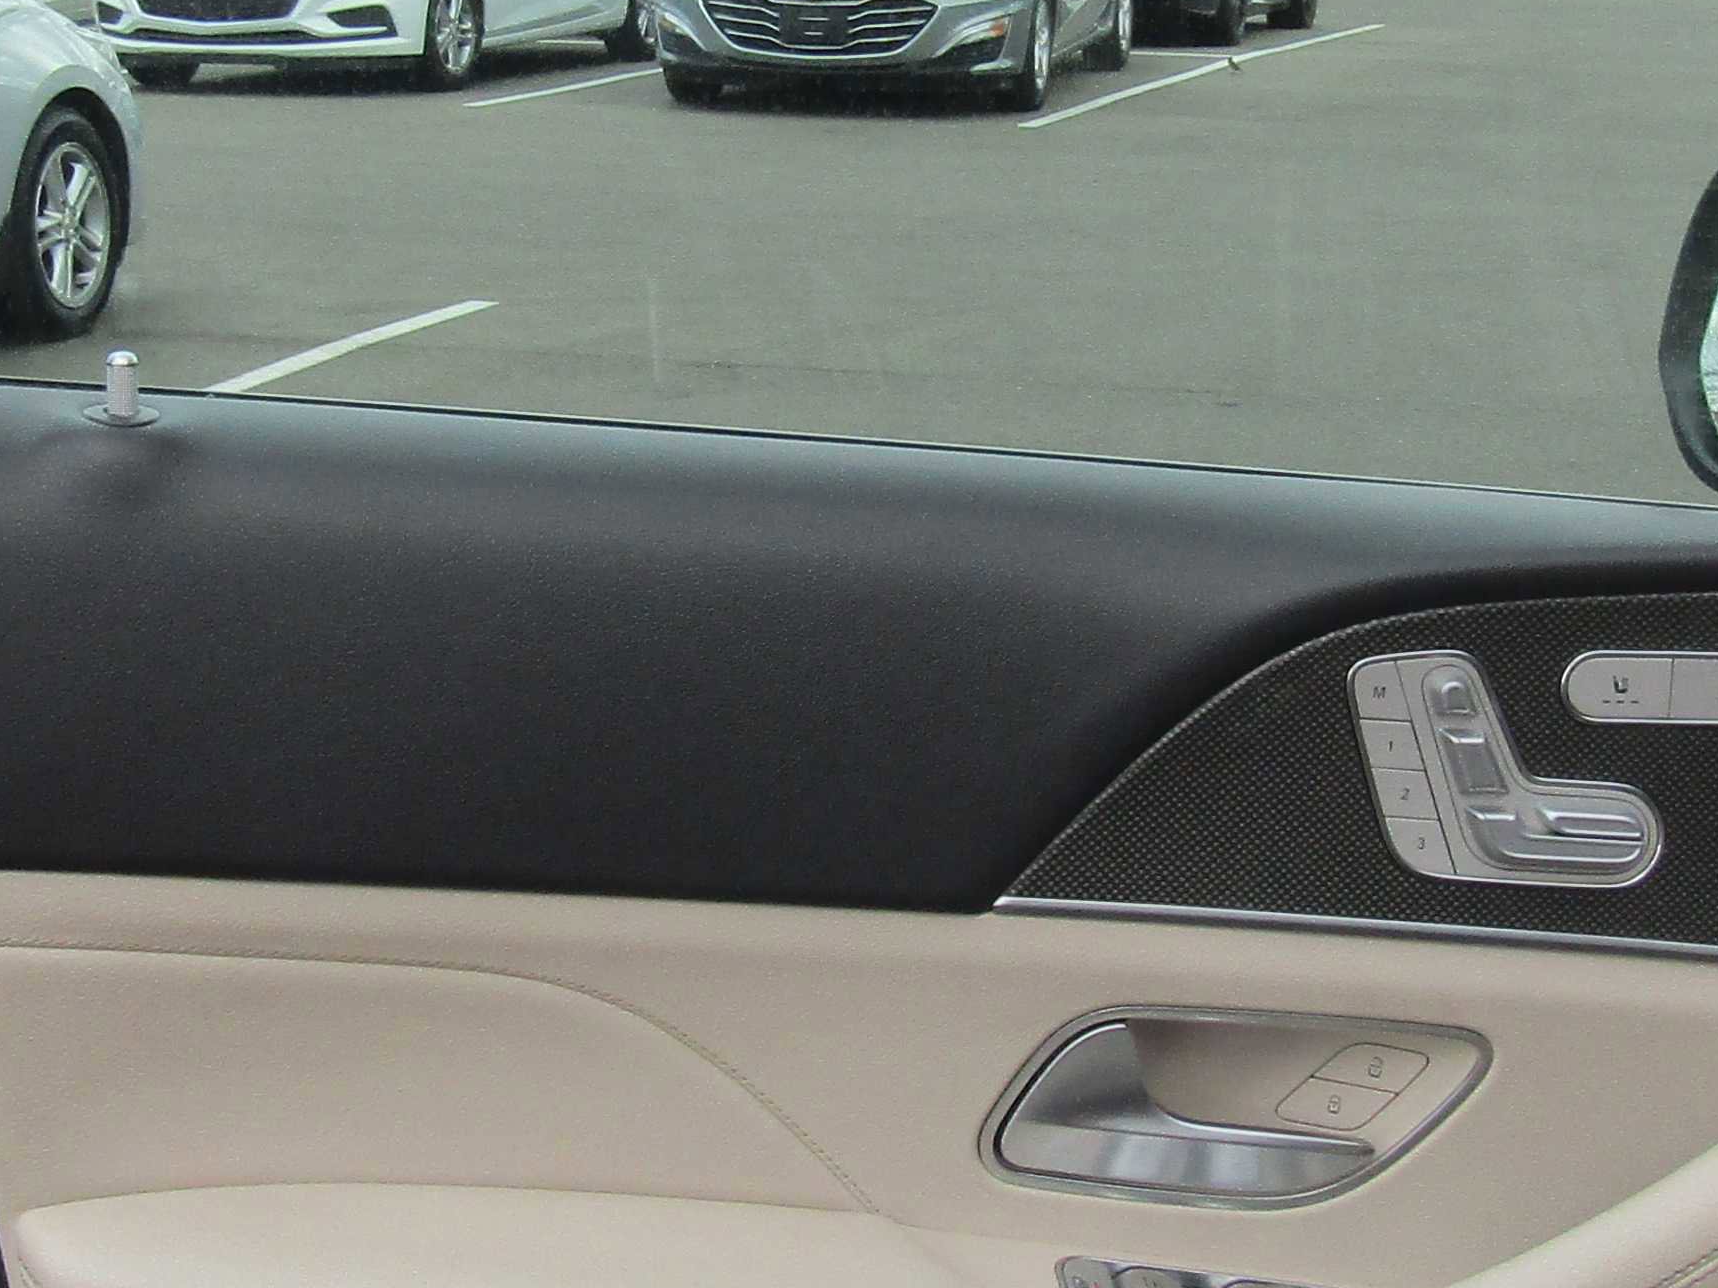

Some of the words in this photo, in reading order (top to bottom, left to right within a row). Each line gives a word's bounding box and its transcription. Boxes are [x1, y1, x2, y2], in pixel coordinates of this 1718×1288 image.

[1371, 686, 1387, 699] M
[1388, 740, 1394, 752] 1
[1399, 787, 1410, 801] 2
[1417, 836, 1426, 851] 3
